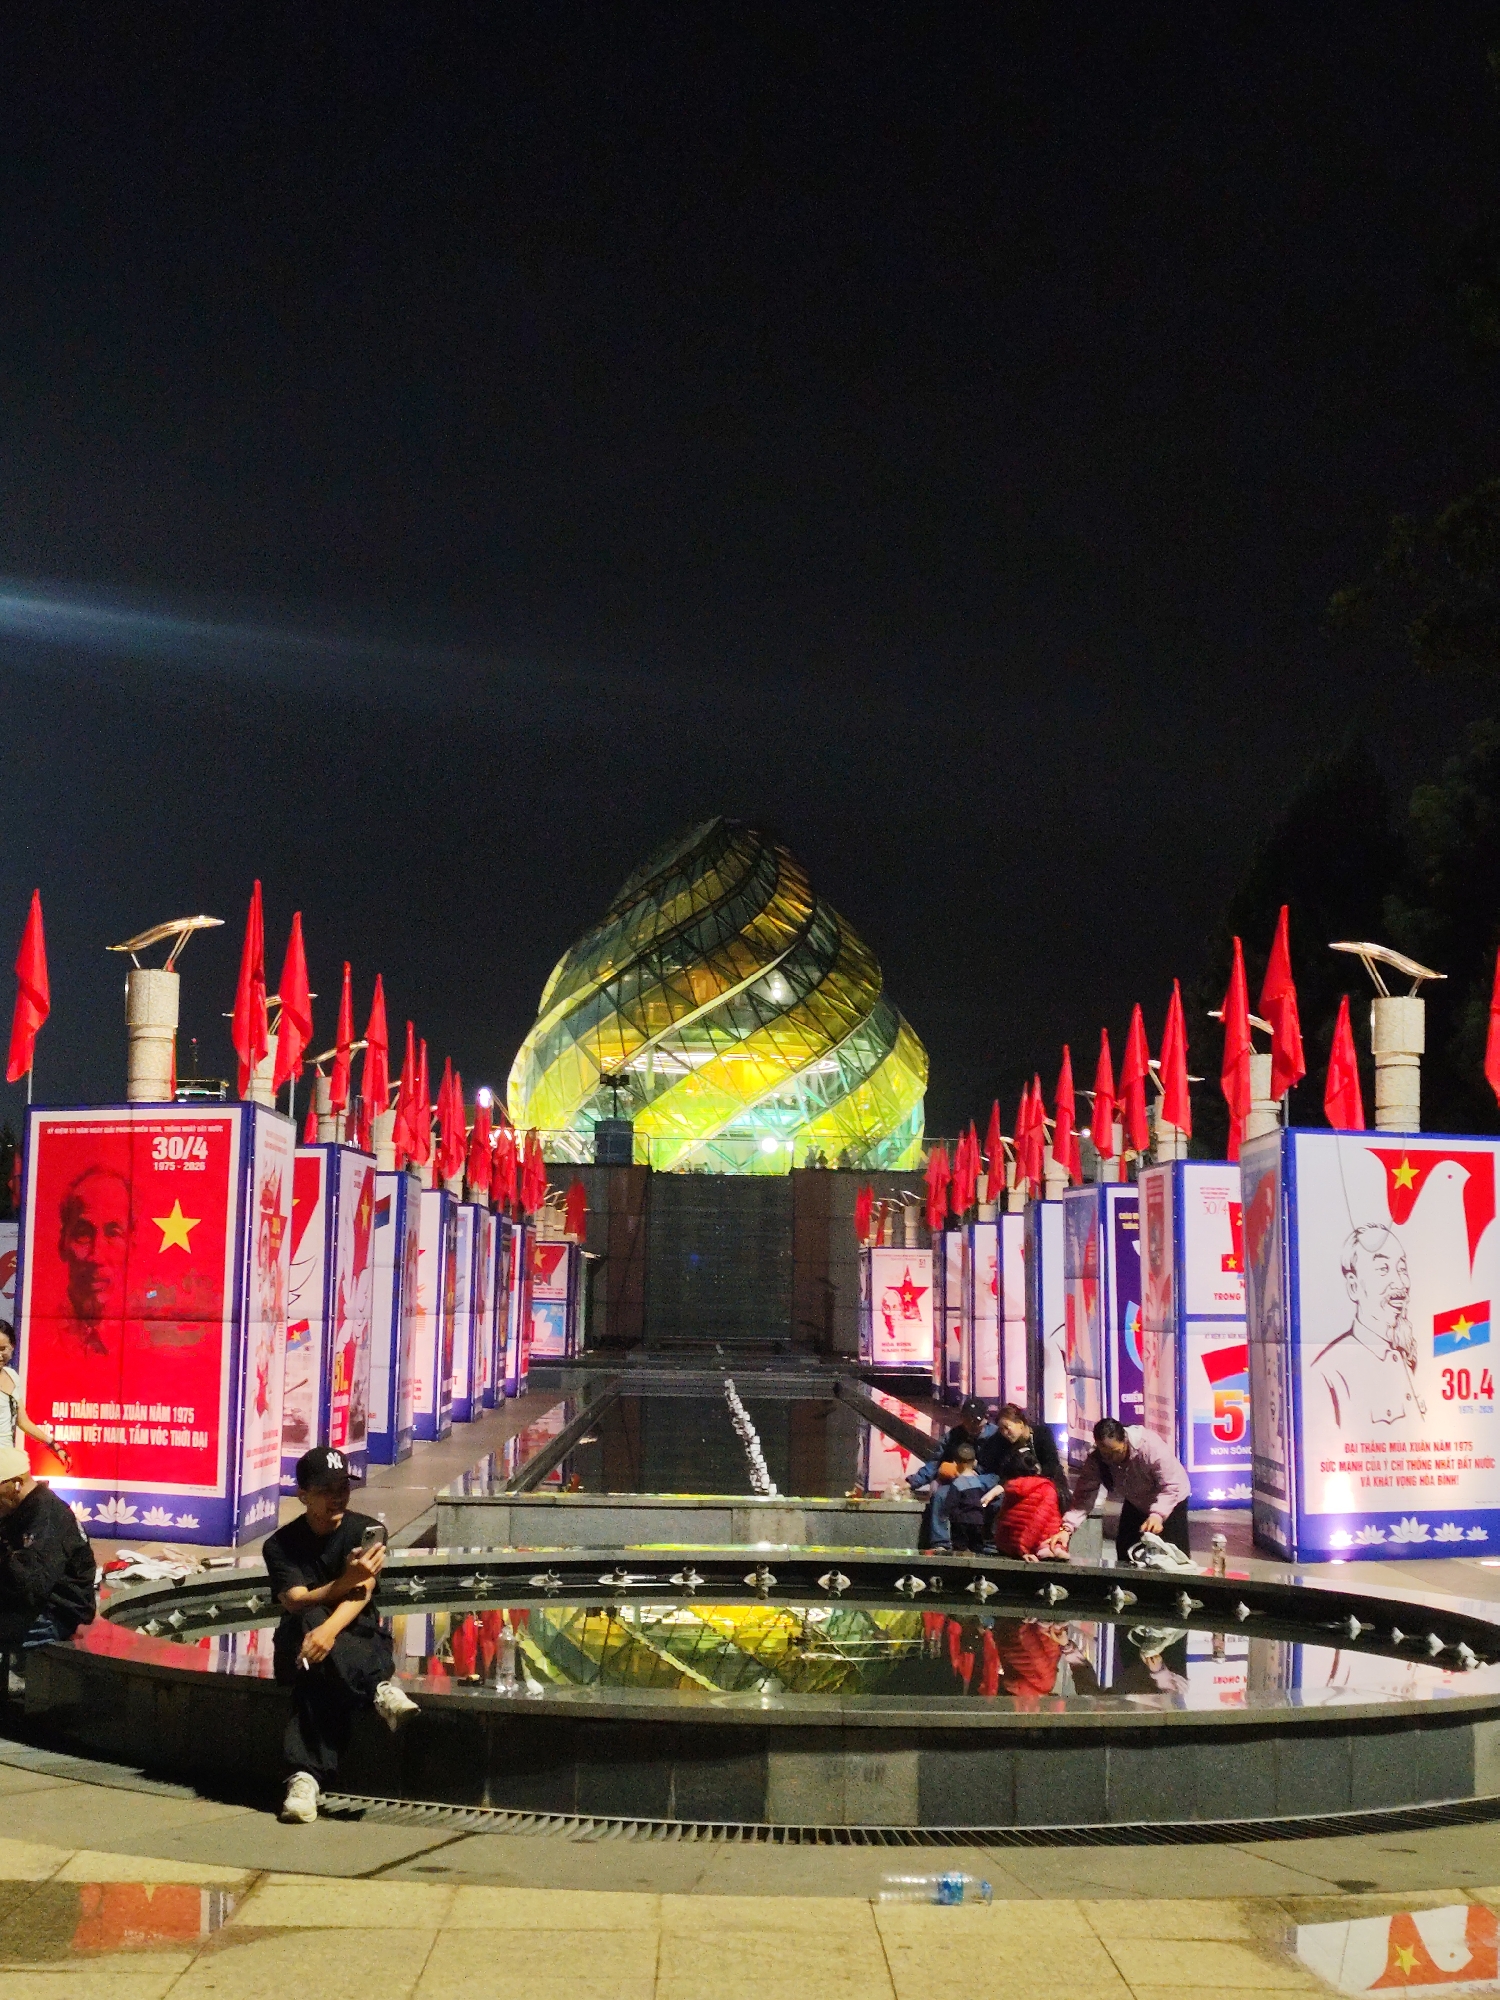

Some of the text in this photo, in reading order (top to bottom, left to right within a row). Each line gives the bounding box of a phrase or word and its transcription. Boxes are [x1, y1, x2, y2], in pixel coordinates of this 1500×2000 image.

[152, 1136, 208, 1160] 30/4
[154, 1161, 175, 1171] 1975
[183, 1161, 206, 1171] 2026
[1214, 1292, 1241, 1301] TRONG
[1442, 1368, 1494, 1400] 30.4
[52, 1397, 195, 1424] ĐẠI THẮNG MÙA XUÂN NĂM 1975
[54, 1424, 82, 1445] MẠNH
[83, 1423, 102, 1446] VIỆT
[103, 1427, 127, 1446] NAM,
[128, 1423, 149, 1445] TẦM
[150, 1426, 169, 1446] VÓC
[170, 1426, 191, 1447] THỜI
[191, 1431, 209, 1451] ĐẠI
[1210, 1447, 1229, 1455] NON
[1345, 1440, 1474, 1456] ĐẠI THẮNG MÙA XUÂN NĂM 1975
[1320, 1456, 1496, 1474] SỨC MẠNH CỦA Ý CHÍ THỐNG NHẤT ĐẤT NƯỚC
[1360, 1475, 1371, 1487] VÀ
[1373, 1475, 1393, 1487] KHÁT
[1396, 1475, 1417, 1489] VỌNG
[1419, 1473, 1435, 1486] HÒA
